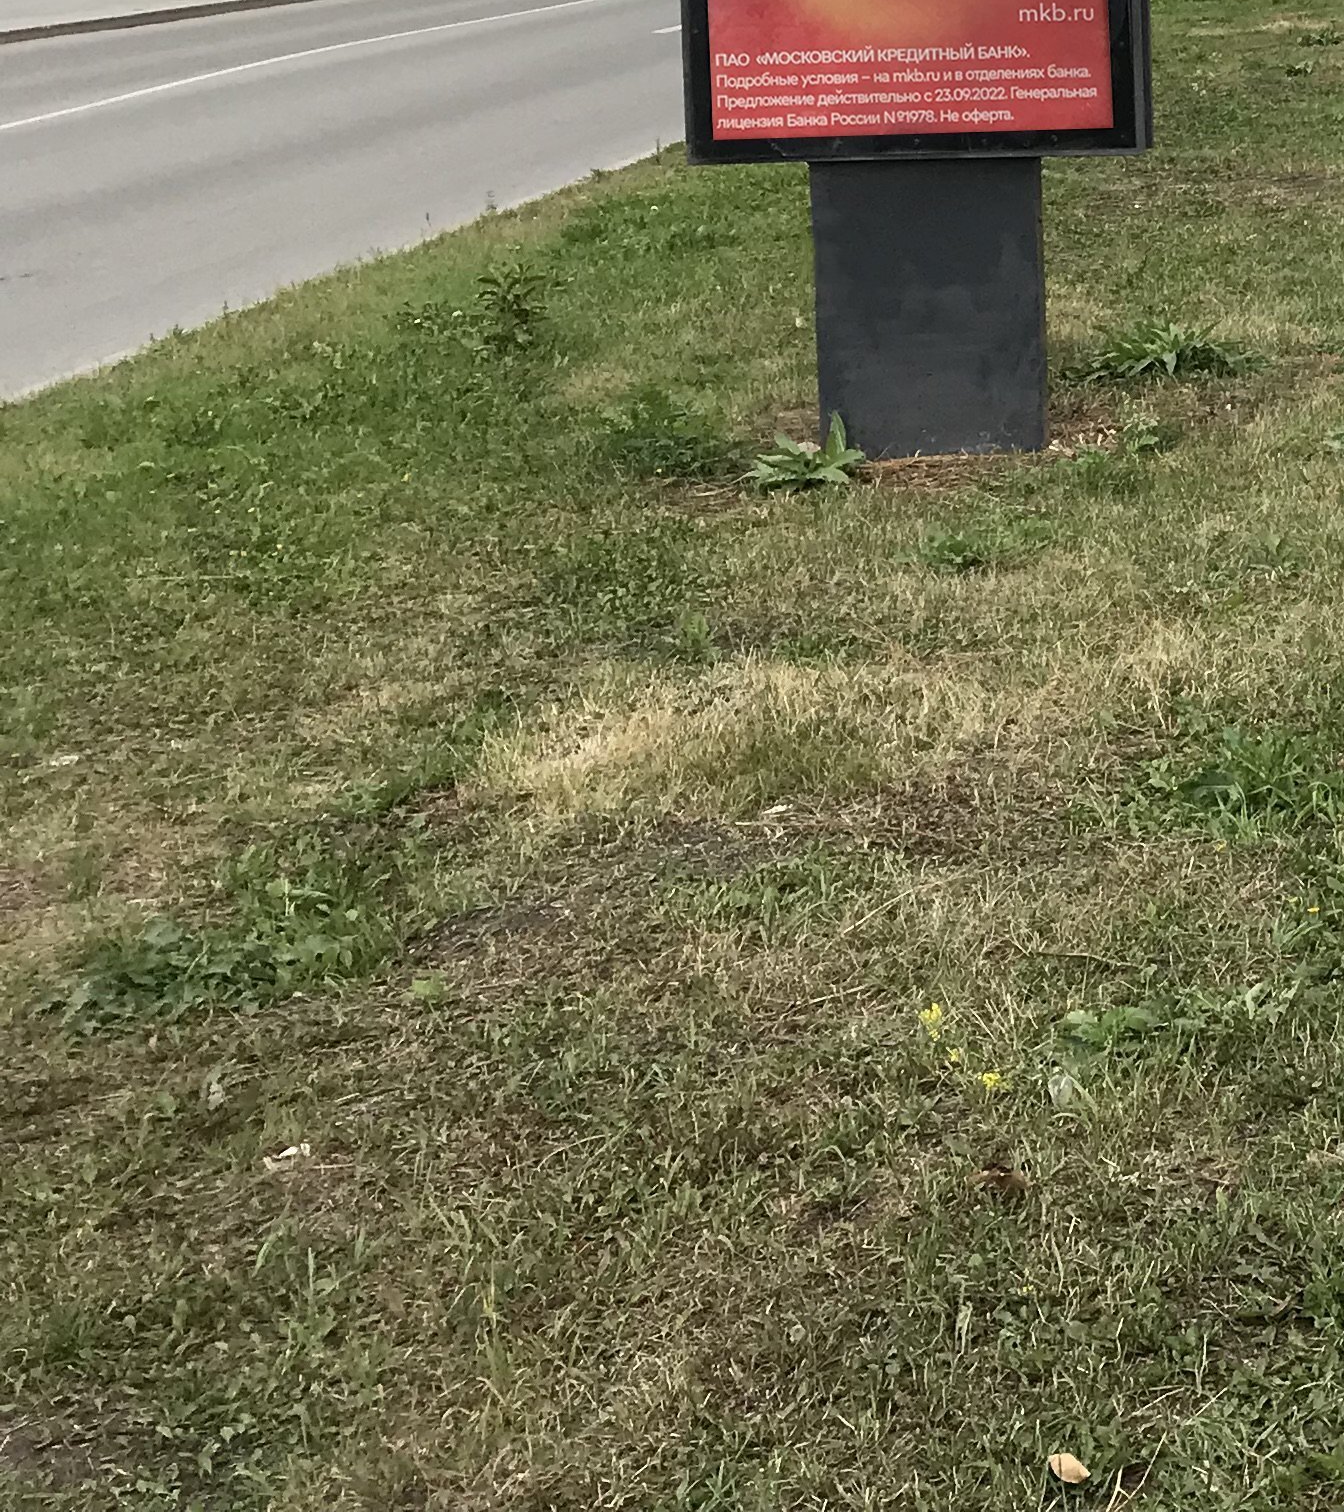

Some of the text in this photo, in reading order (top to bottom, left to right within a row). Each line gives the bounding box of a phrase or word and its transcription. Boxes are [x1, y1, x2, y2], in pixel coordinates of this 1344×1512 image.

[1018, 2, 1095, 23] mkb.ru
[715, 43, 1031, 67] ПАО «МОСКОВСКИЙ КРЕДИТНЫЙ БАНК».
[716, 73, 799, 90] Подробные
[801, 72, 858, 88] условия
[874, 72, 890, 83] на
[893, 68, 940, 82] mkb.ru
[943, 70, 952, 81] и
[955, 70, 963, 81] в
[965, 67, 1045, 82] отделениях
[1047, 64, 1092, 78] банка.
[717, 85, 1098, 110] Предложение действительно с 23.09.2022. Генеральная
[716, 116, 784, 130] лицензия
[787, 113, 828, 127] Банка
[831, 111, 881, 126] России
[940, 108, 959, 123] Не
[962, 108, 1014, 125] оферта.
